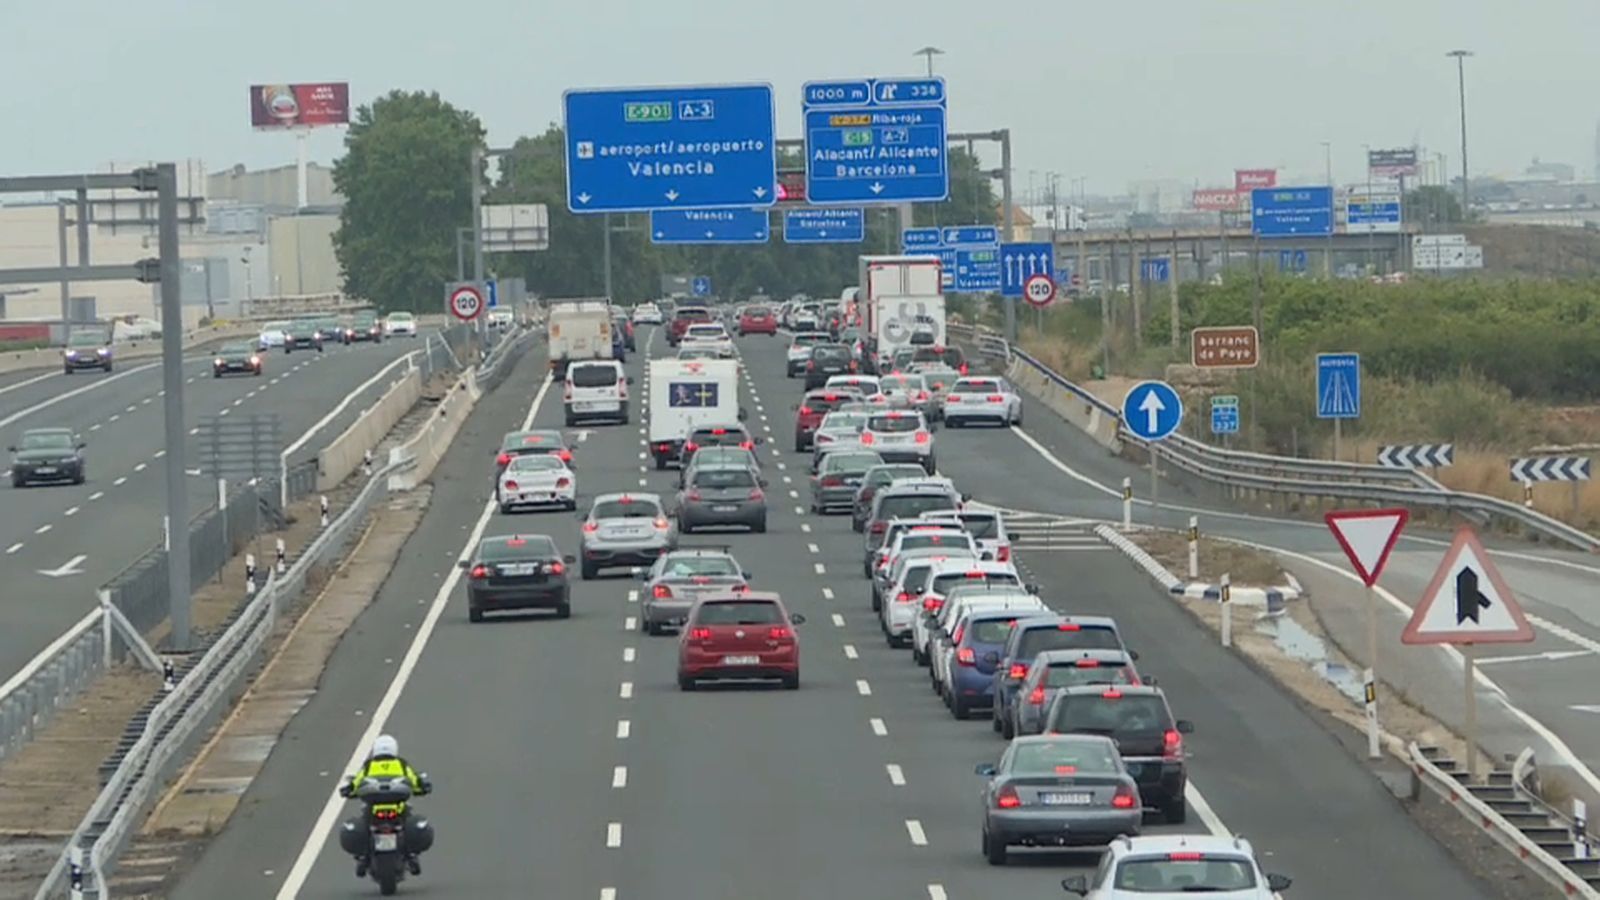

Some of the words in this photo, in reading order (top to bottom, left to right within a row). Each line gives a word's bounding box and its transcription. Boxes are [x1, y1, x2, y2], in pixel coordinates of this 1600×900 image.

[811, 88, 845, 99] 1000
[852, 89, 863, 99] m
[627, 104, 669, 118] E-901
[682, 103, 711, 117] A-3
[872, 113, 922, 124] Riba-roja
[886, 130, 906, 142] A-7
[677, 138, 764, 155] aeropuerto
[814, 145, 876, 161] Alacant/
[878, 145, 940, 159] Alicante
[628, 160, 715, 177] Valencia
[835, 163, 917, 177] Barcelona
[1030, 283, 1049, 295] 120
[456, 296, 477, 309] 120
